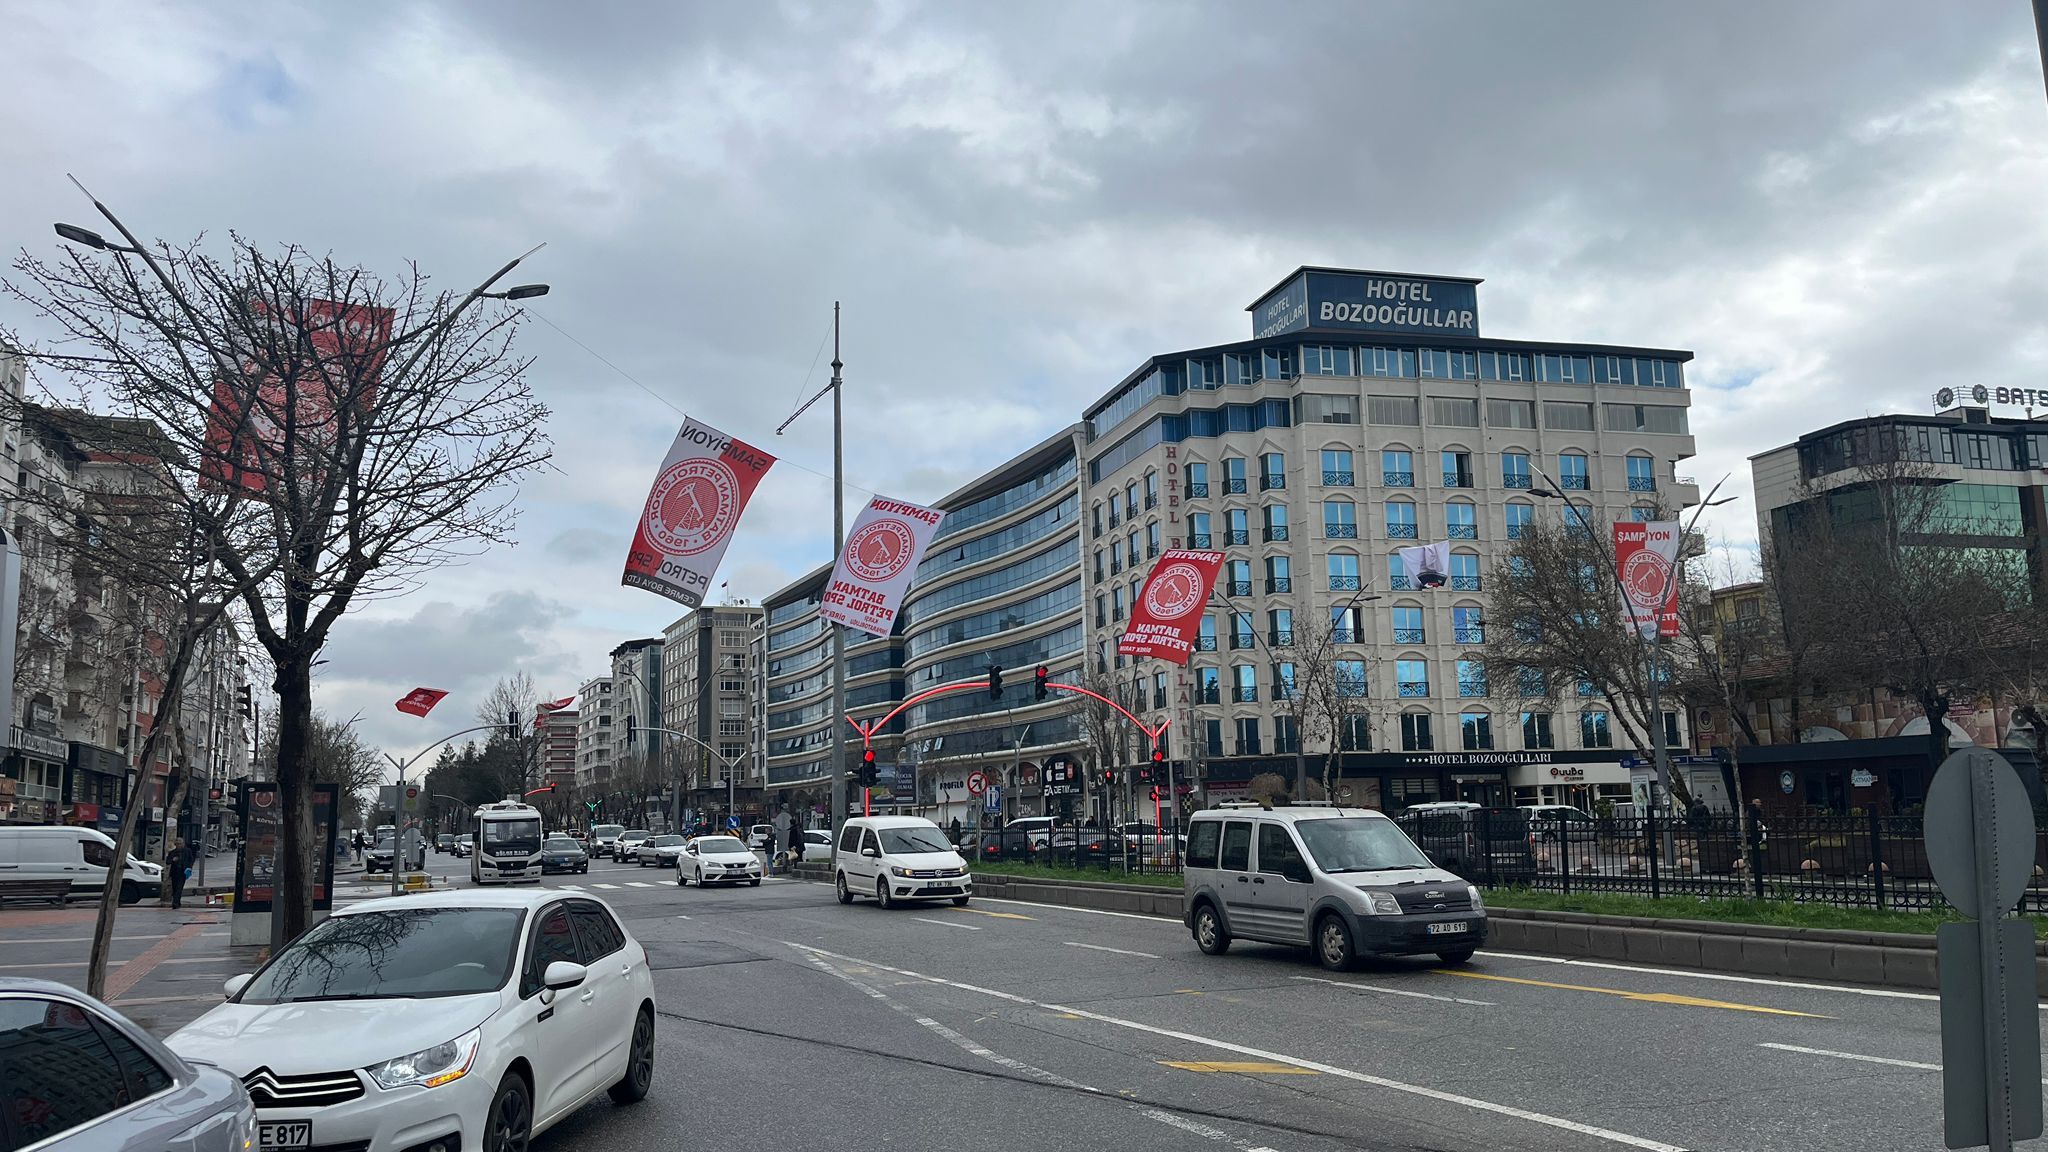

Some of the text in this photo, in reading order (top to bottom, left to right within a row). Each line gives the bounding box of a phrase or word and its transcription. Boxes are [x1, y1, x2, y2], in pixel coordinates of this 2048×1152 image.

[1366, 279, 1432, 302] HOTEL
[1268, 296, 1290, 320] HOTEL
[1320, 301, 1473, 329] BOZOOĞULLAR
[1166, 446, 1180, 524] HOTEL
[1618, 530, 1670, 543] ŞAMPİYON
[1429, 752, 1551, 764] HOTEL BOZOOĞULLARI
[1431, 924, 1440, 932] 72
[1453, 922, 1466, 931] 613
[276, 1124, 307, 1145] 817
